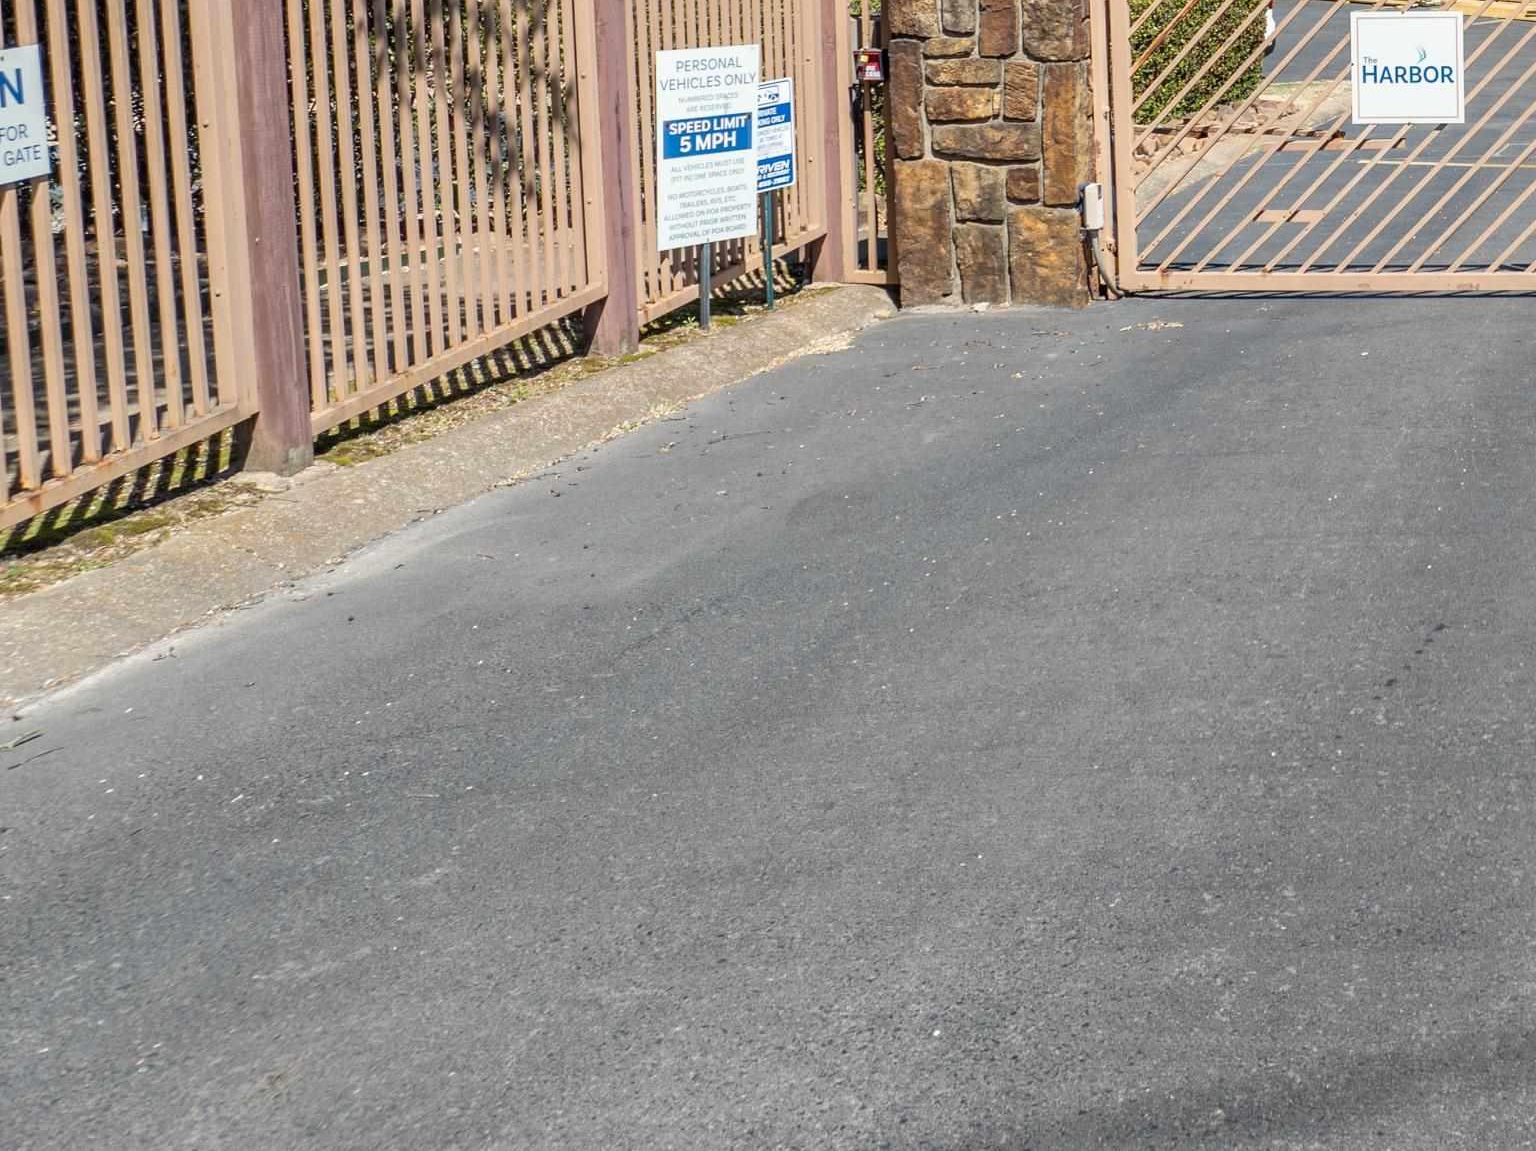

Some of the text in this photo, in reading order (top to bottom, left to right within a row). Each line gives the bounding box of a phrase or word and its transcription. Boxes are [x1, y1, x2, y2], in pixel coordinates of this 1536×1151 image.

[676, 56, 743, 72] PERSONAL
[660, 72, 757, 91] VEHICLES ONLY
[1362, 65, 1455, 84] HARBOR
[0, 124, 28, 144] FOR
[669, 115, 748, 135] SPEED LIMIT
[680, 135, 692, 152] 5
[695, 130, 737, 151] MPH
[4, 144, 42, 166] GATE
